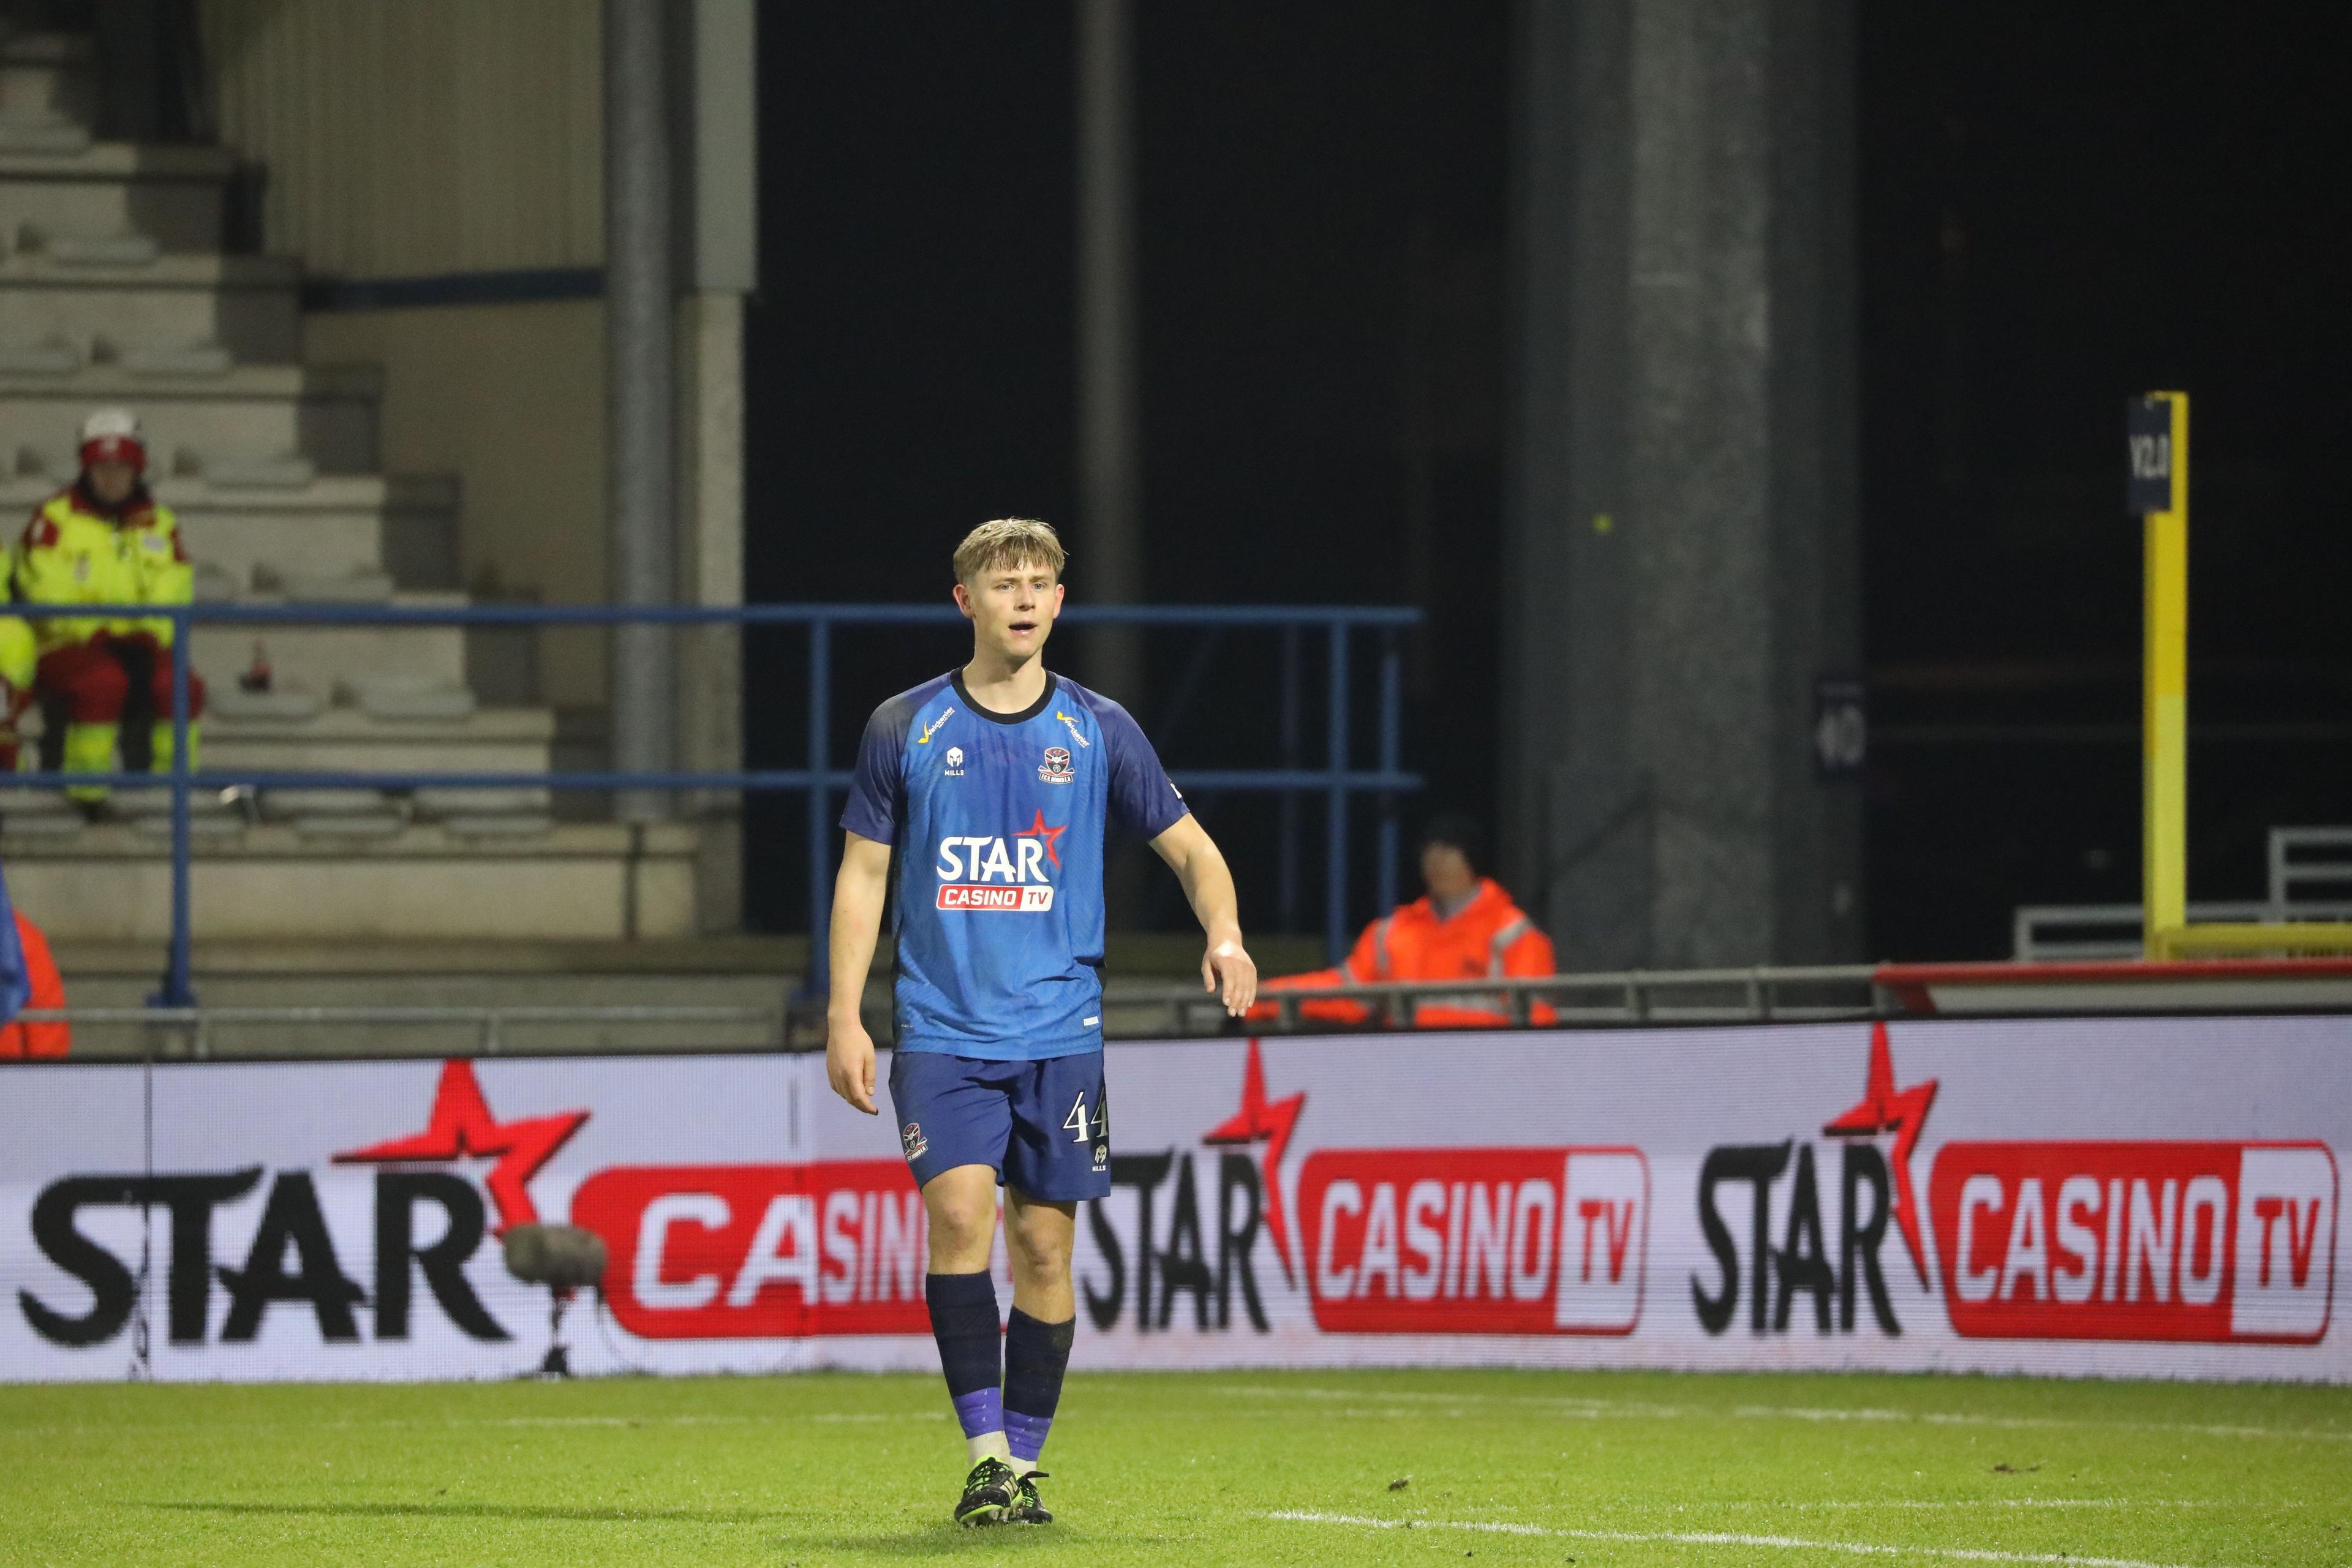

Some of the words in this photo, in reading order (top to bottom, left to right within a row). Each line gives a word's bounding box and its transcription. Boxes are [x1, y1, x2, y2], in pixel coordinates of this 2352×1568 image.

[927, 706, 954, 736] Valckenier
[1065, 719, 1090, 747] Valckenier
[936, 835, 1049, 882] STAR
[944, 889, 1017, 906] CASINO
[1027, 891, 1049, 905] TV
[1063, 1088, 1109, 1143] 44
[17, 1163, 515, 1344] STAR
[632, 1188, 929, 1310] CASIN
[1080, 1145, 1272, 1333] STAR
[1316, 1177, 1557, 1302] CASINO
[1578, 1199, 1634, 1285] TV
[1691, 1137, 1903, 1337] STAR
[1955, 1174, 2228, 1305] CASINO
[2253, 1197, 2321, 1289] TV
